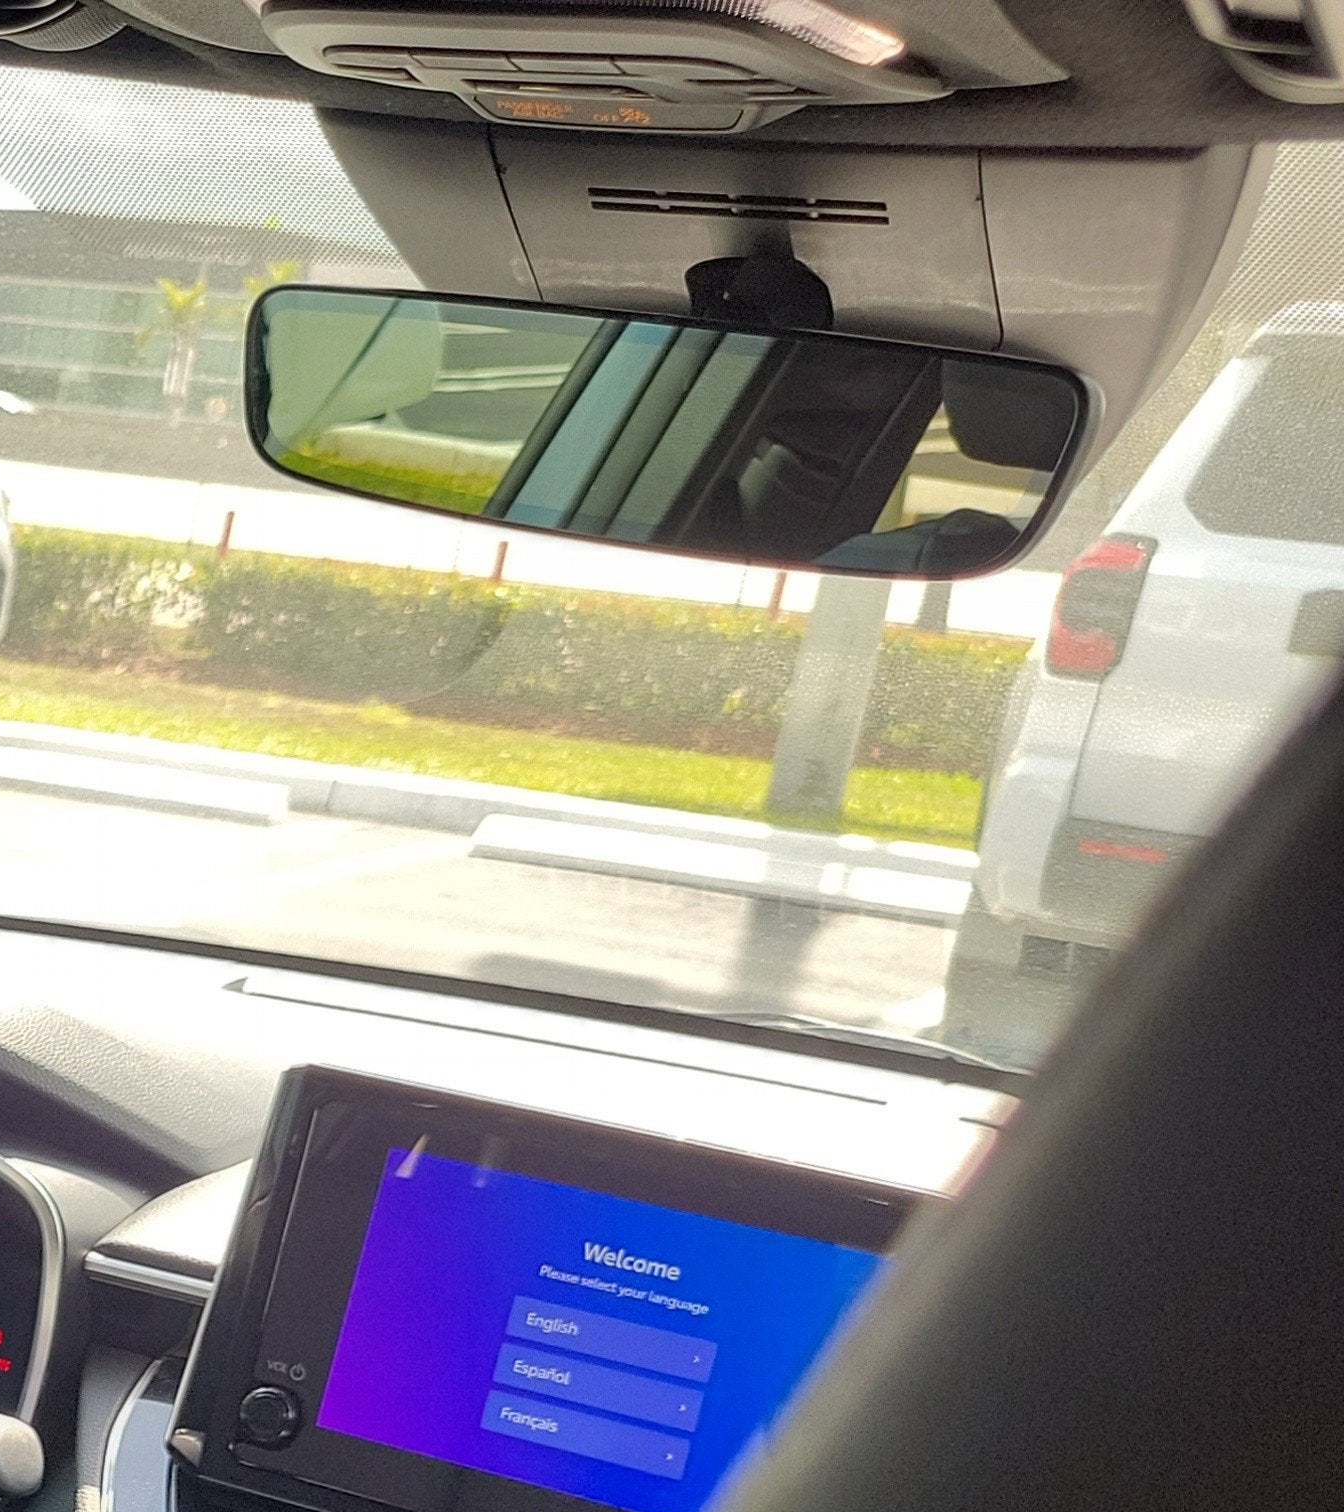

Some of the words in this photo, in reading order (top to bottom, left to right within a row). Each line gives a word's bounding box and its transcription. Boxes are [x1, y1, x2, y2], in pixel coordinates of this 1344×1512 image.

[584, 1241, 682, 1282] Welcome
[539, 1263, 581, 1285] Please
[581, 1274, 617, 1295] select
[617, 1285, 648, 1301] your
[648, 1289, 710, 1316] language
[525, 1311, 580, 1336] English
[512, 1359, 572, 1386] Español
[499, 1406, 559, 1434] Français
